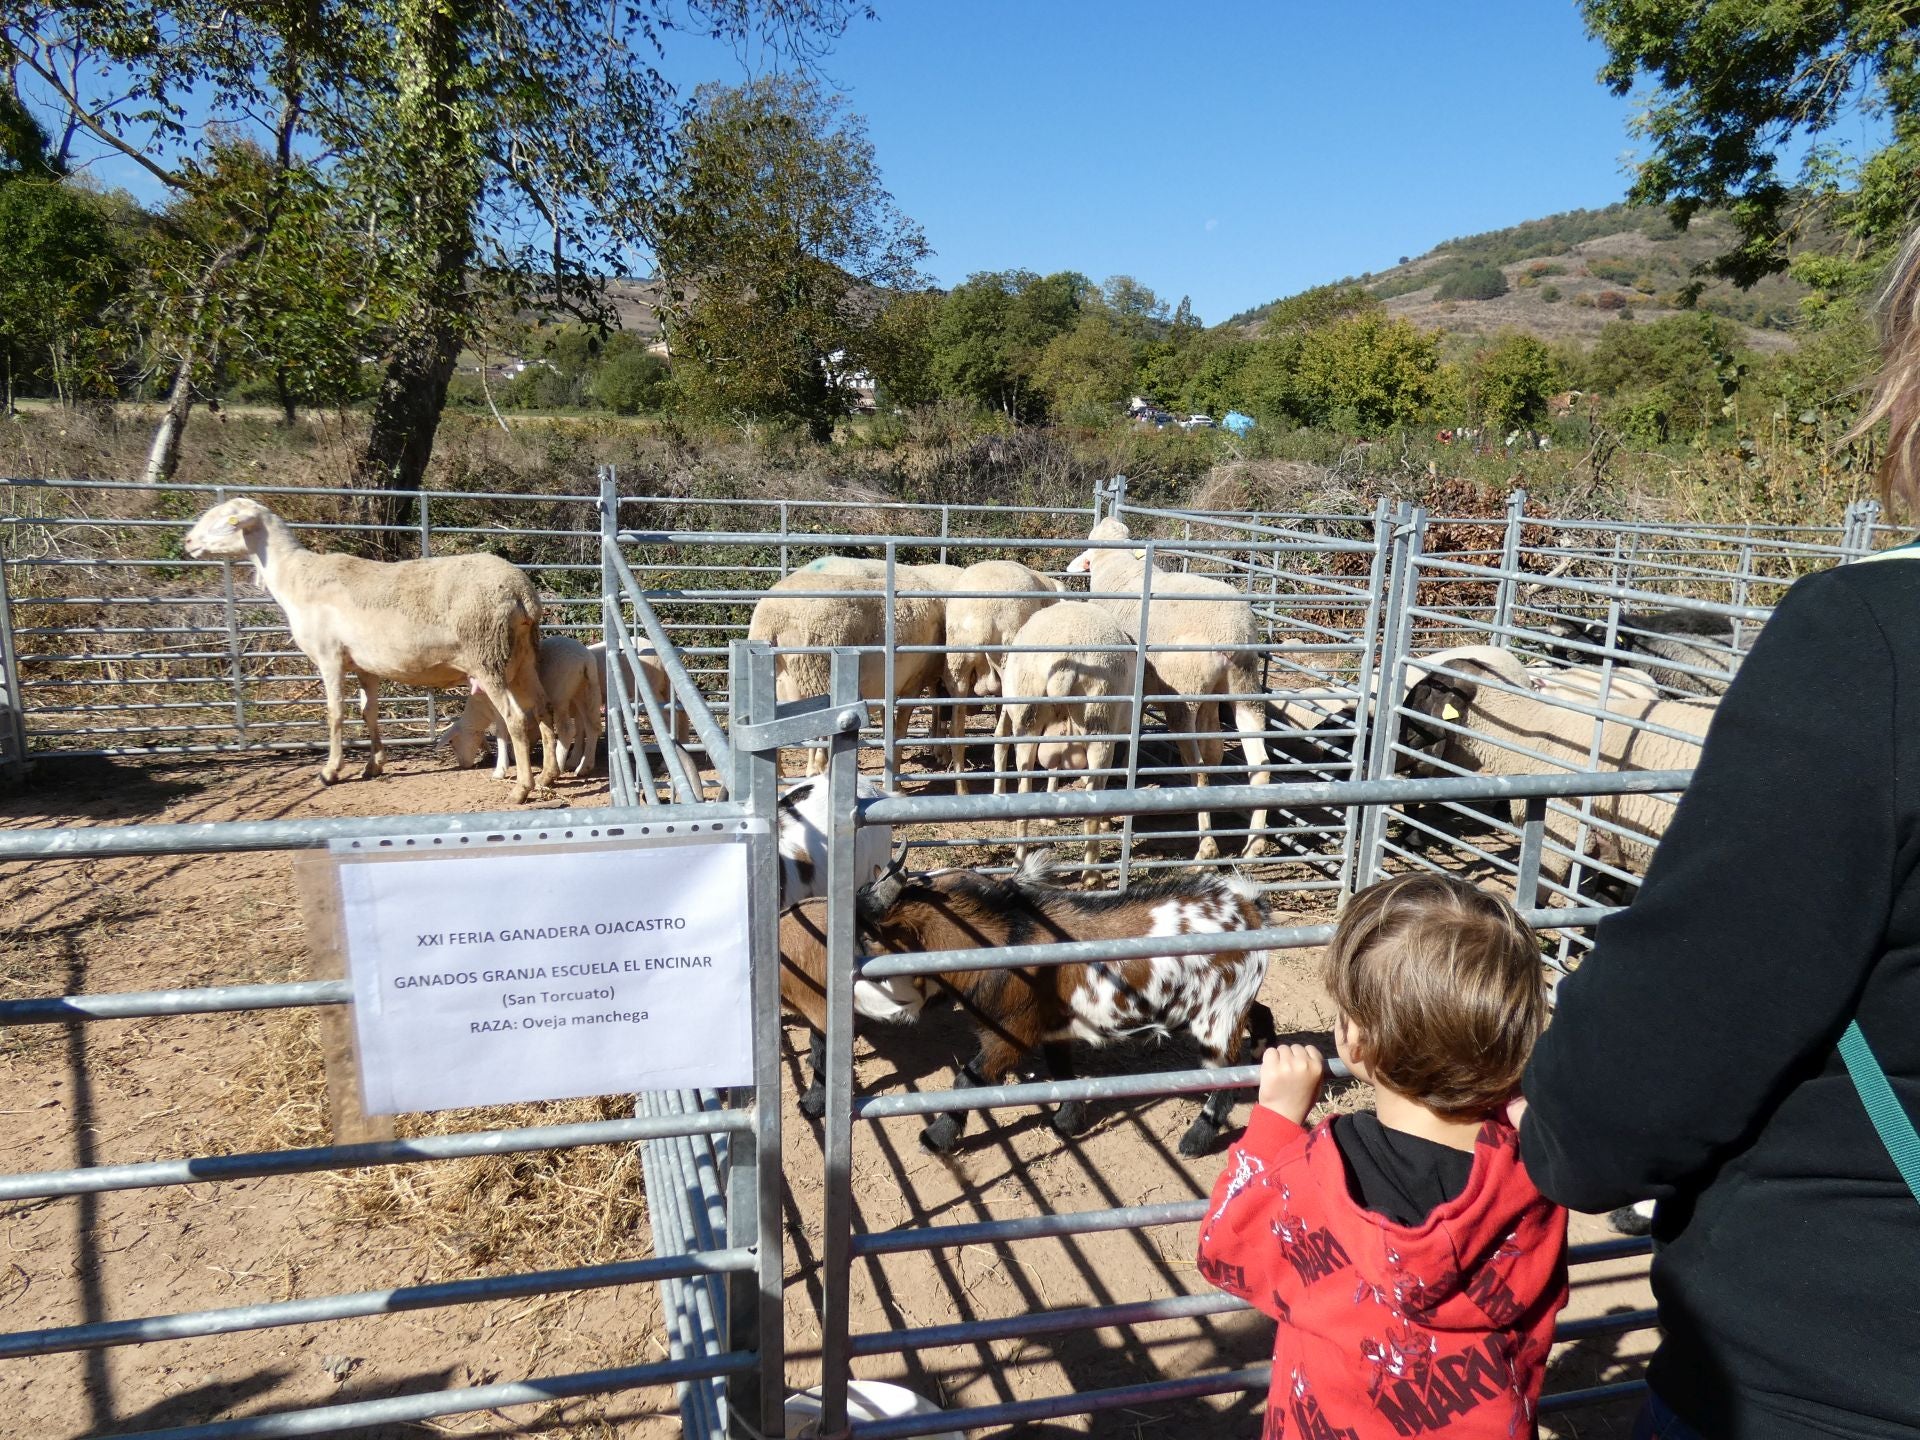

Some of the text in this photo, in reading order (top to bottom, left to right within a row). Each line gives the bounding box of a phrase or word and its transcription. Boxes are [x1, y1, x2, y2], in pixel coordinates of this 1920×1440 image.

[417, 916, 686, 947] XXI FERIA GANADERA OJACASTRO
[394, 955, 712, 989] GANADOS GRANJA ESCUELA EL ENCINAR
[502, 985, 615, 1009] (San Torcuato)
[470, 1009, 649, 1034] RAZA: Oveja manchega
[1367, 1331, 1515, 1437] MARV
